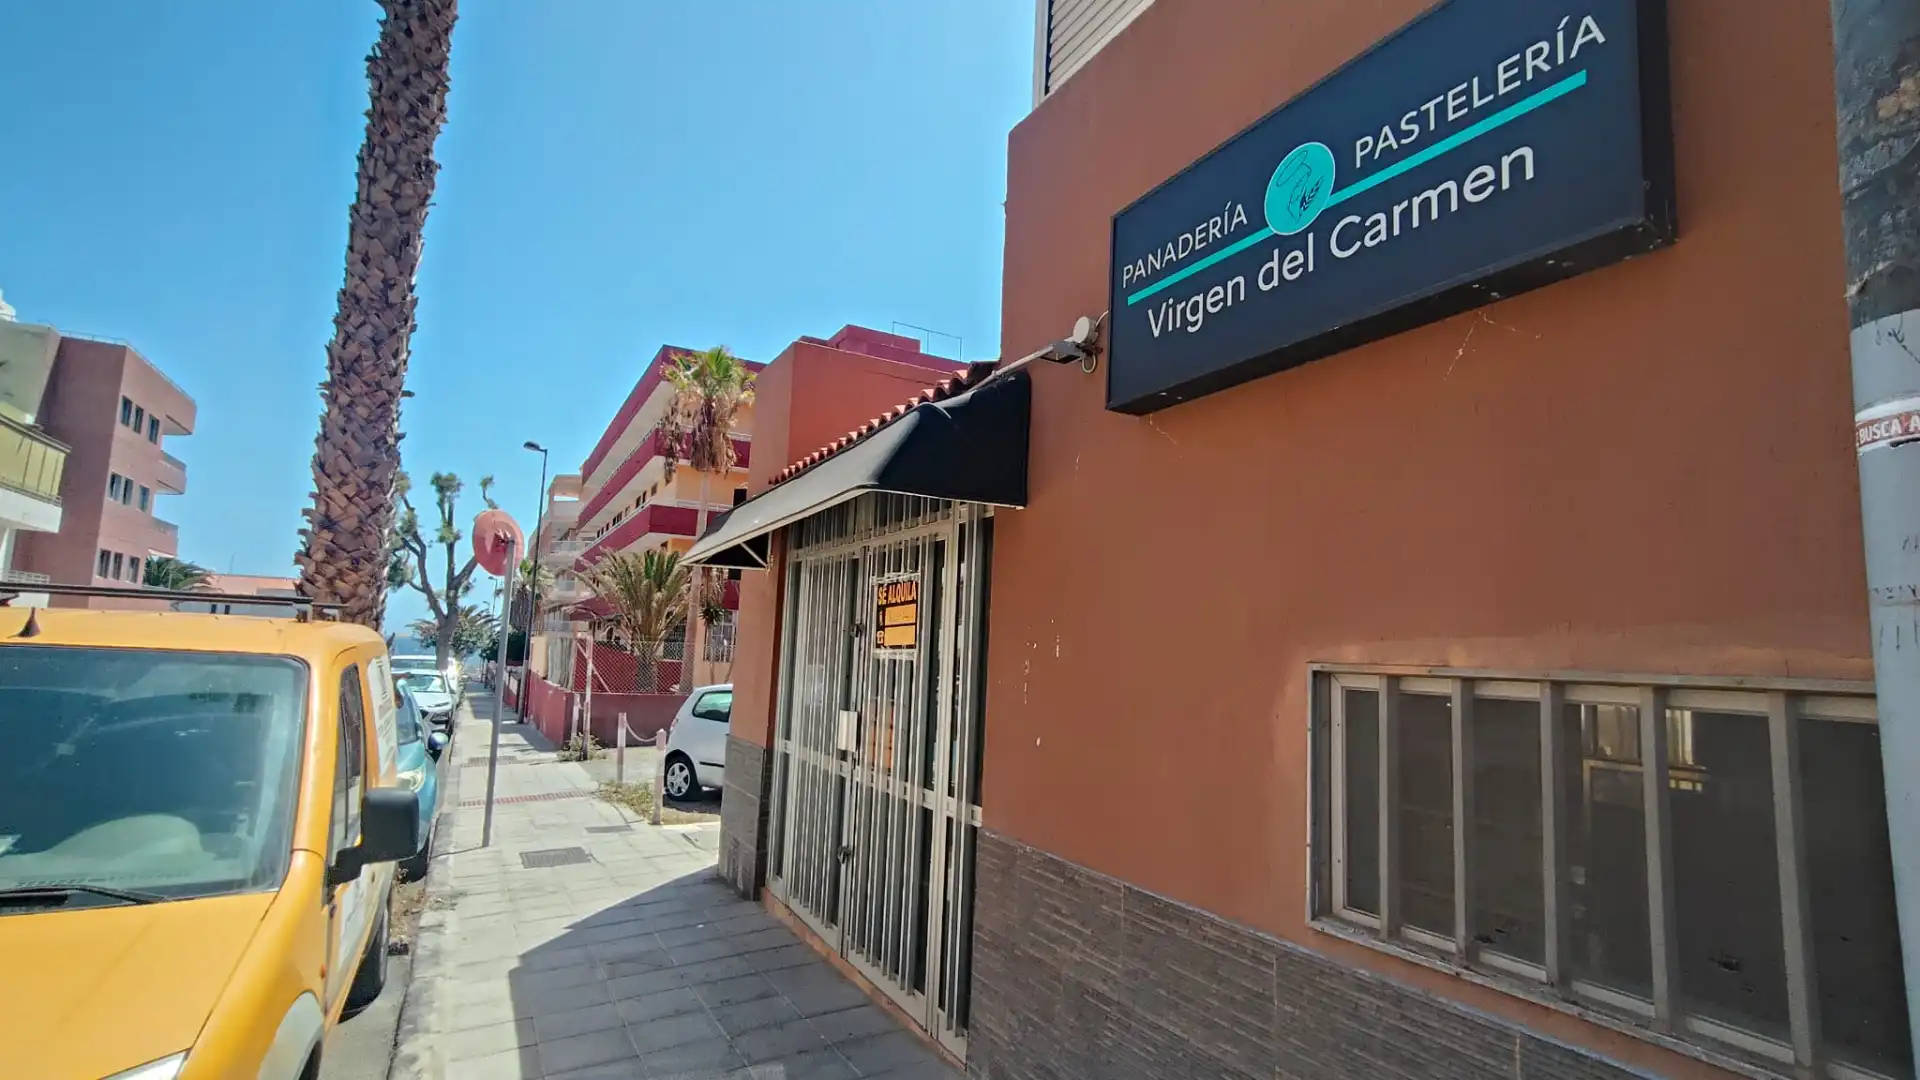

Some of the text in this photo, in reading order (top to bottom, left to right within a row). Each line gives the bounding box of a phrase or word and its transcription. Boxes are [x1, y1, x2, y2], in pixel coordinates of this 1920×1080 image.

[1354, 14, 1606, 168] PASTELERÍA
[1122, 202, 1248, 289] PANADERÍA
[1147, 145, 1536, 338] Virgen del Carmen
[878, 582, 917, 605] SE ALQUILA
